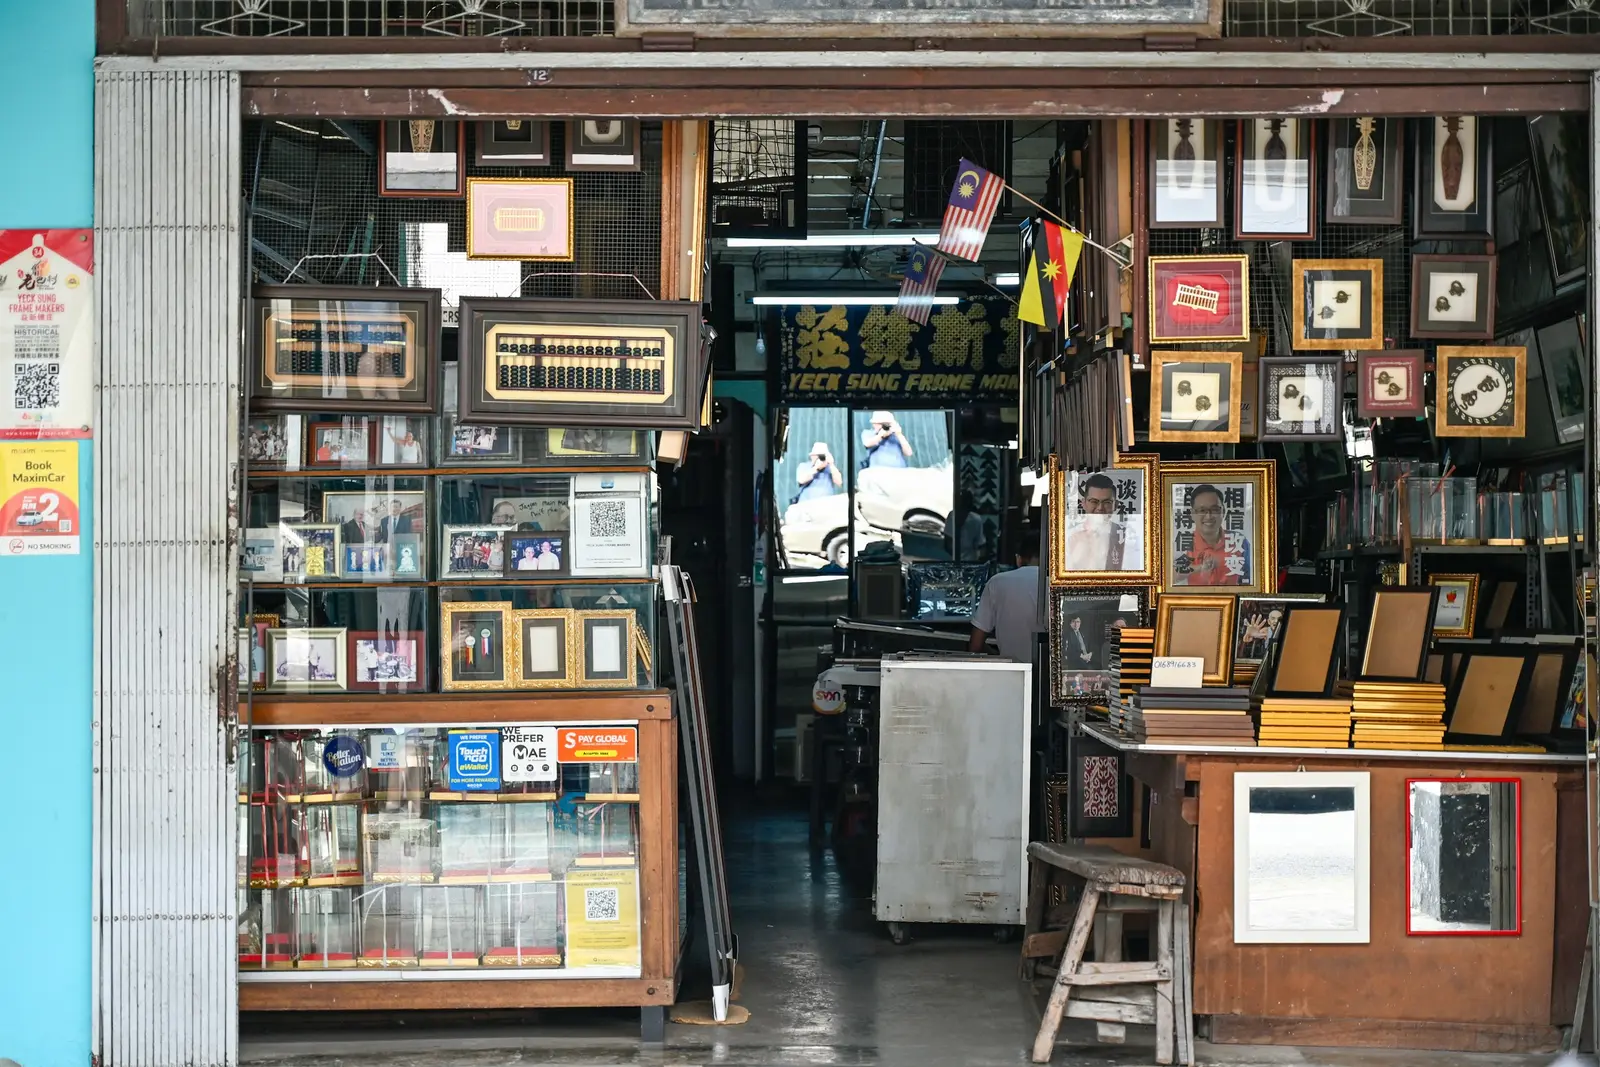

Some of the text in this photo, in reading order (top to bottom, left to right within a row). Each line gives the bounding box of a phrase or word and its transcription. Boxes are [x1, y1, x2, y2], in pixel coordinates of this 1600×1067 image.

[533, 70, 547, 80] 12
[34, 247, 43, 257] 34
[18, 294, 56, 303] YECK SUNG
[9, 304, 65, 313] FRAME MAKERS
[14, 328, 59, 336] HISTORICAL
[788, 373, 842, 392] YECK
[845, 373, 903, 392] SUNG
[905, 373, 975, 392] FRAME
[25, 461, 52, 470] Book
[13, 473, 66, 482] MaximCar
[39, 493, 59, 521] 2
[1224, 487, 1246, 576] 相信改变
[503, 727, 521, 735] WE
[502, 734, 544, 743] PREFER
[578, 735, 594, 743] PAY
[595, 735, 628, 743] GLOBAL
[459, 747, 488, 755] Touch
[460, 763, 489, 771] eWallet
